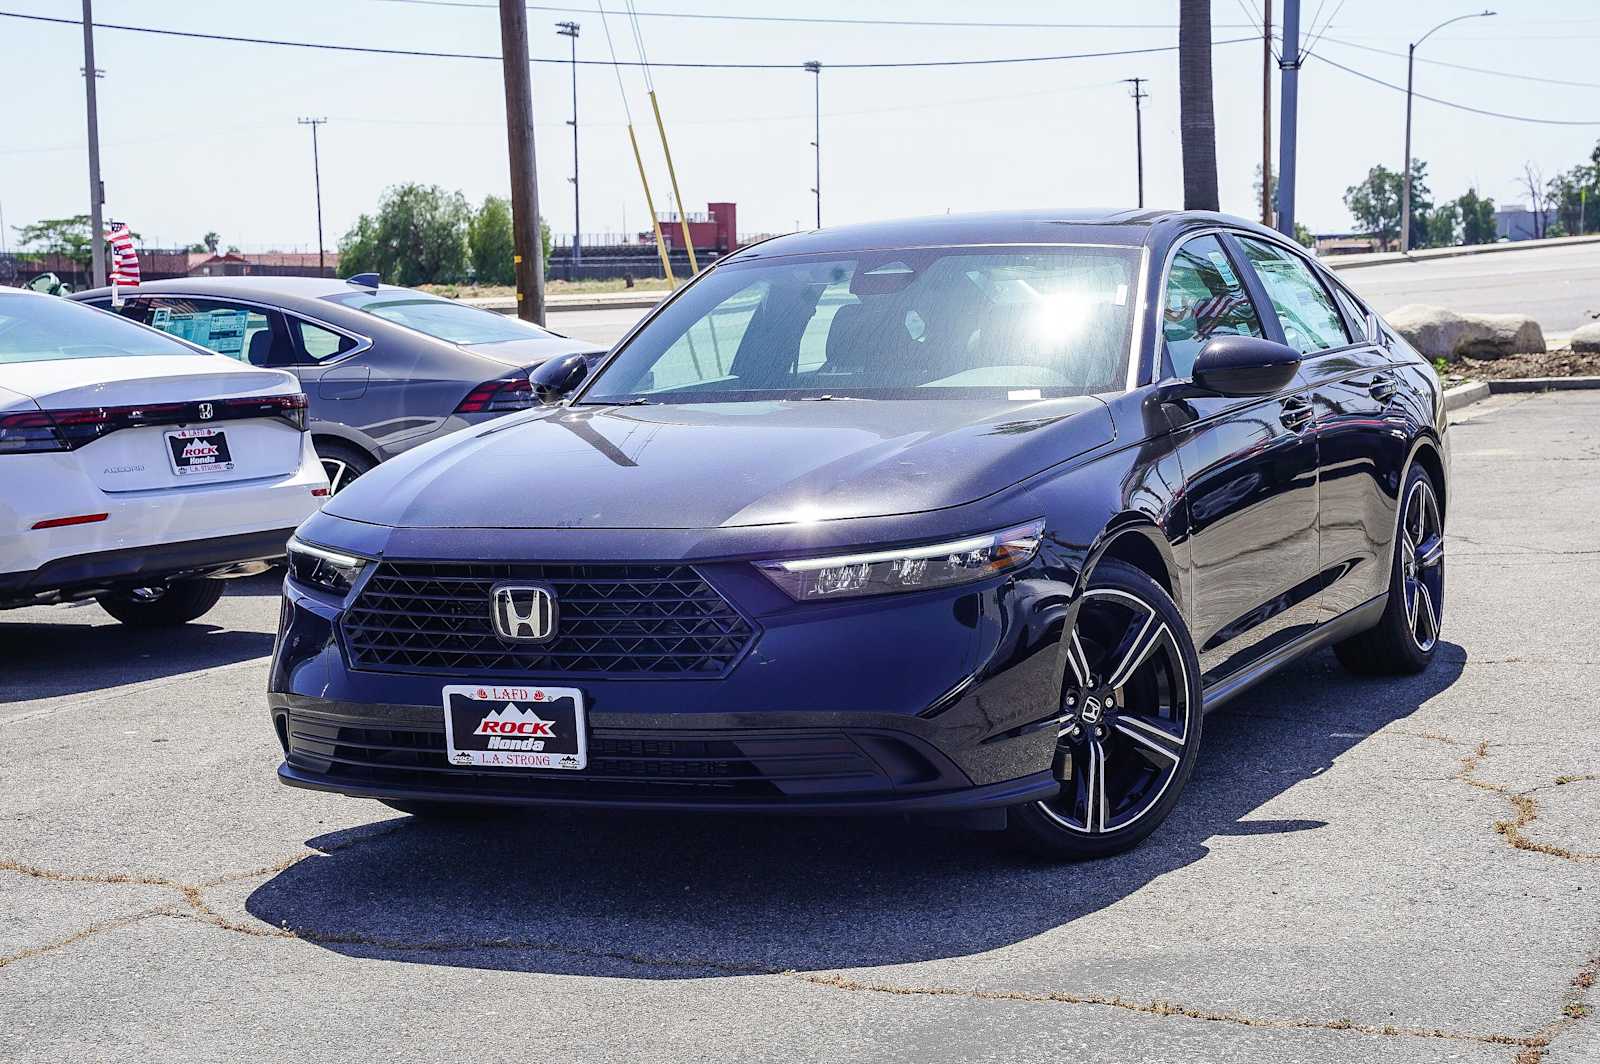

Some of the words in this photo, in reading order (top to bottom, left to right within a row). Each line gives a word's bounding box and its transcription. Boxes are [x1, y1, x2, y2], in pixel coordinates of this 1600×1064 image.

[185, 447, 216, 456] ROCK
[190, 456, 215, 465] Honda
[492, 688, 528, 700] LAFD
[481, 721, 549, 735] ROCK
[487, 736, 545, 751] Honda
[481, 753, 504, 764] L.A.
[506, 755, 551, 766] STRONG
